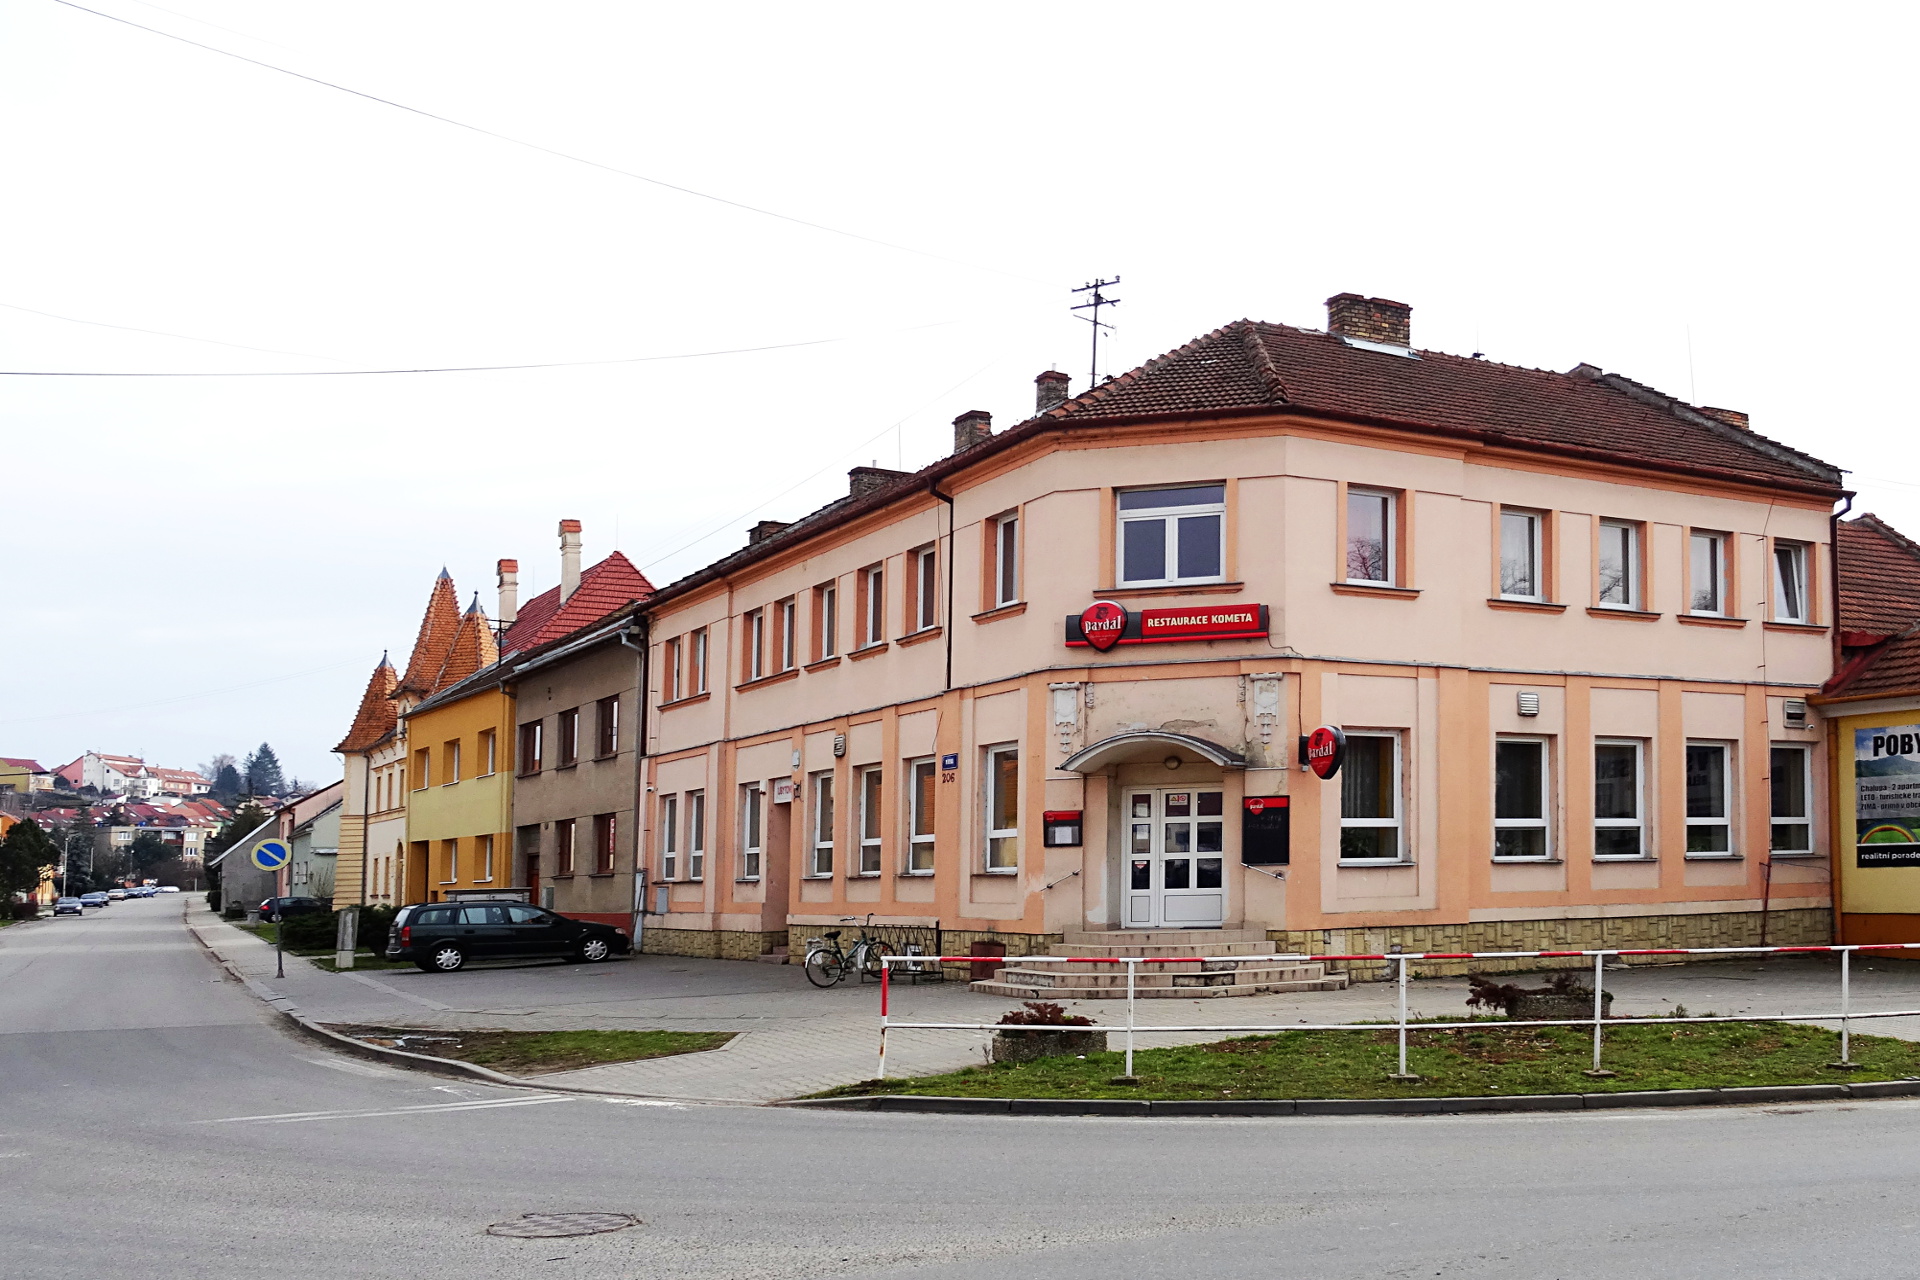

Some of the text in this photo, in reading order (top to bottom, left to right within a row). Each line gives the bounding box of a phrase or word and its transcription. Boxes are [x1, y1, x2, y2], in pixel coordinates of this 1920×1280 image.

[1085, 616, 1121, 634] pardál
[1148, 613, 1253, 626] RESTAURACE KOMETA
[942, 773, 955, 784] 206
